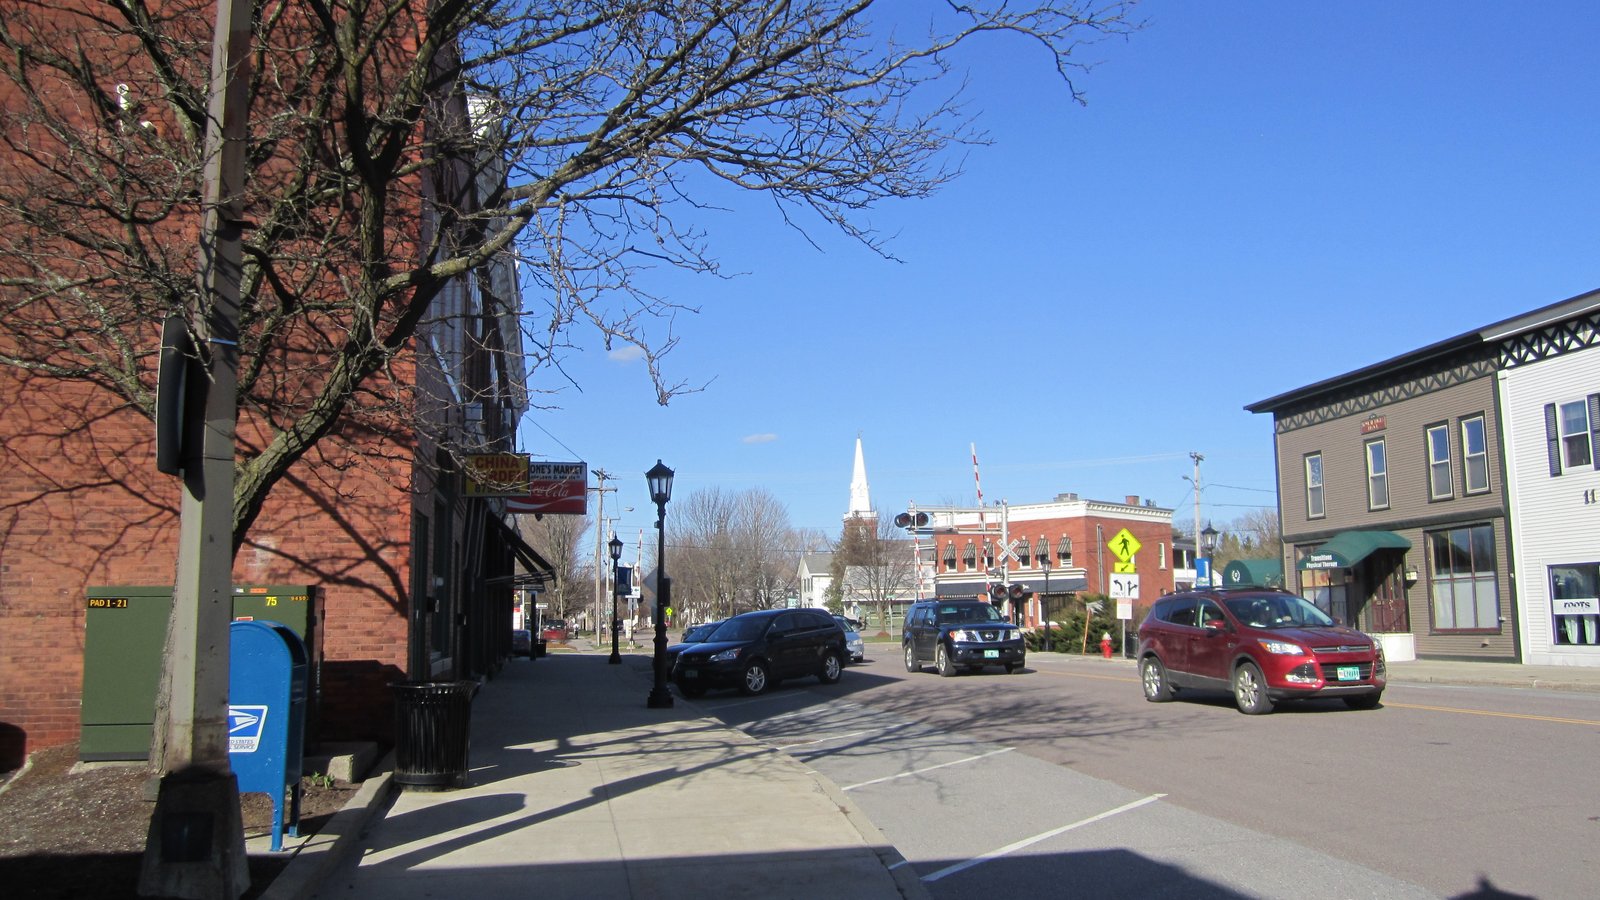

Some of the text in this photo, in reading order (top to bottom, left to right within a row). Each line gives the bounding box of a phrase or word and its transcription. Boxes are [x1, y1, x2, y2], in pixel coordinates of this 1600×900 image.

[475, 456, 519, 468] CHINA
[530, 465, 583, 474] ONE'S MARKET
[1584, 489, 1597, 505] 11
[90, 599, 105, 607] PAD
[265, 597, 277, 606] 75
